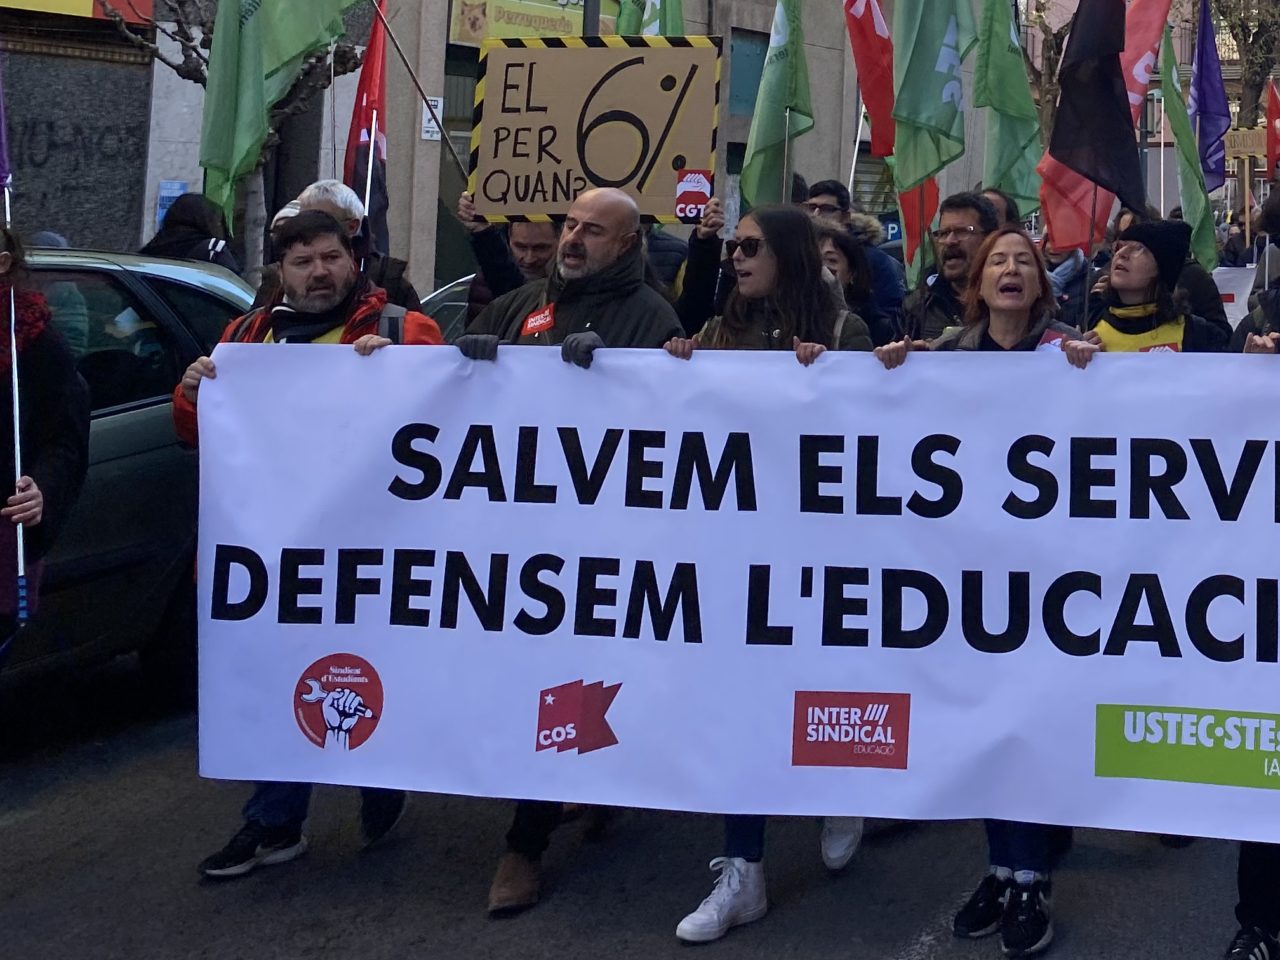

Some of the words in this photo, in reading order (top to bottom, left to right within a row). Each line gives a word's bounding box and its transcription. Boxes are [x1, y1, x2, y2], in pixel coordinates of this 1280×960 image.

[501, 61, 548, 114] EL
[576, 56, 699, 194] 6%
[492, 124, 562, 165] PER
[675, 203, 706, 218] CGT
[887, 223, 899, 241] P
[387, 422, 758, 512] SALVEM
[799, 433, 964, 519] ELS
[210, 543, 704, 644] DEFENSEM
[329, 665, 361, 675] Sindicat
[807, 706, 863, 725] INTER
[538, 723, 577, 746] COS
[806, 724, 896, 744] SINDICAL
